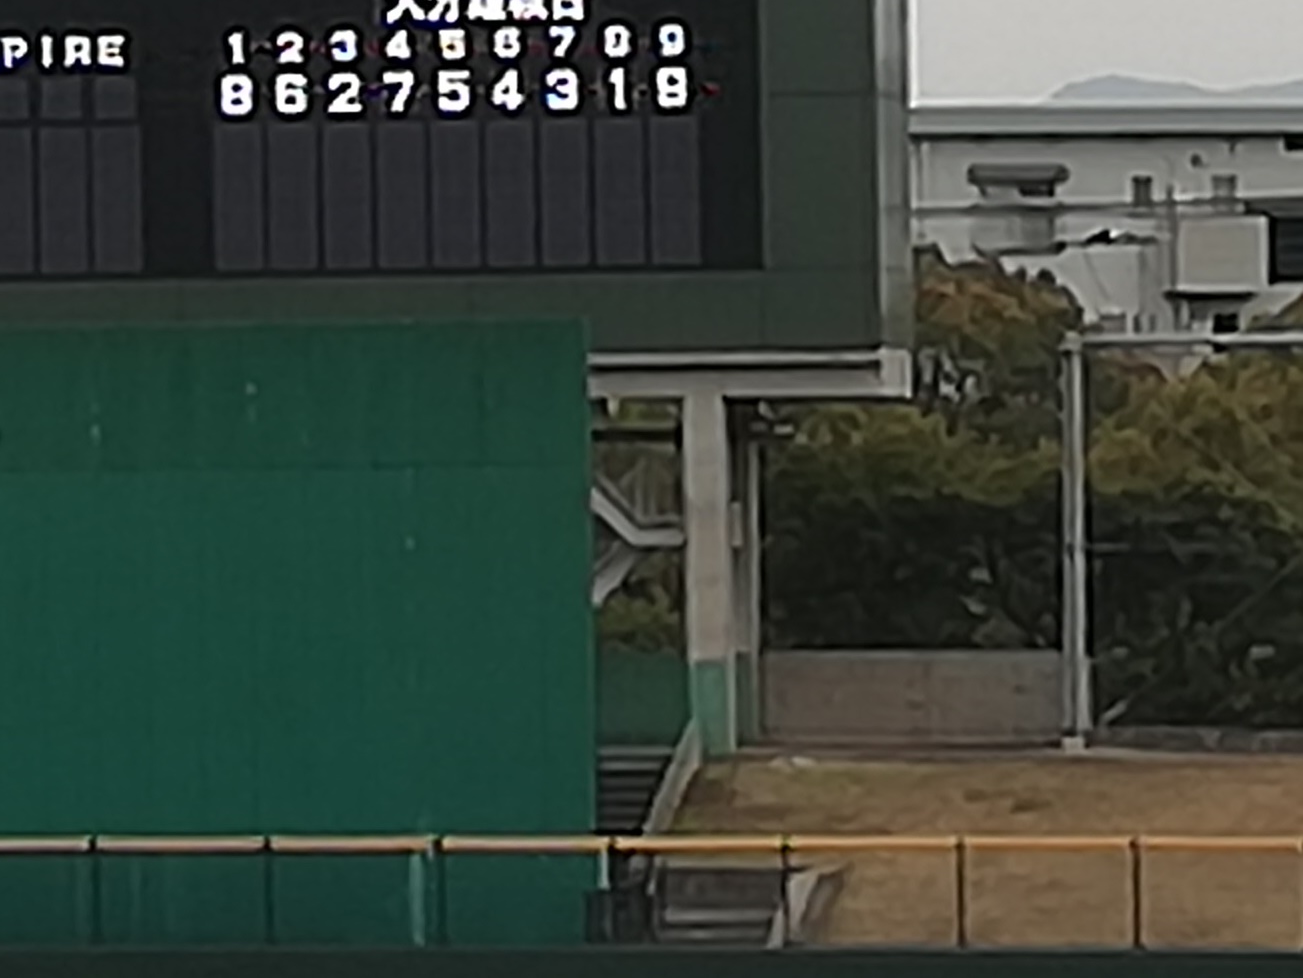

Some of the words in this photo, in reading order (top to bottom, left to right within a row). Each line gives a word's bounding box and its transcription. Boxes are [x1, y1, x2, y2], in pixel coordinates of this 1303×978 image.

[229, 33, 244, 63] 1
[277, 32, 303, 63] 2
[330, 30, 356, 61] 3
[386, 30, 410, 58] 4
[439, 29, 465, 59] 5
[550, 26, 575, 56] 7
[659, 24, 684, 56] 9
[221, 75, 252, 114] 8
[276, 74, 307, 113] 6
[328, 73, 362, 112] 2
[383, 71, 413, 111] 7
[438, 70, 469, 111] 5
[492, 70, 523, 110] 4
[546, 69, 578, 109] 3
[610, 68, 626, 109] 1
